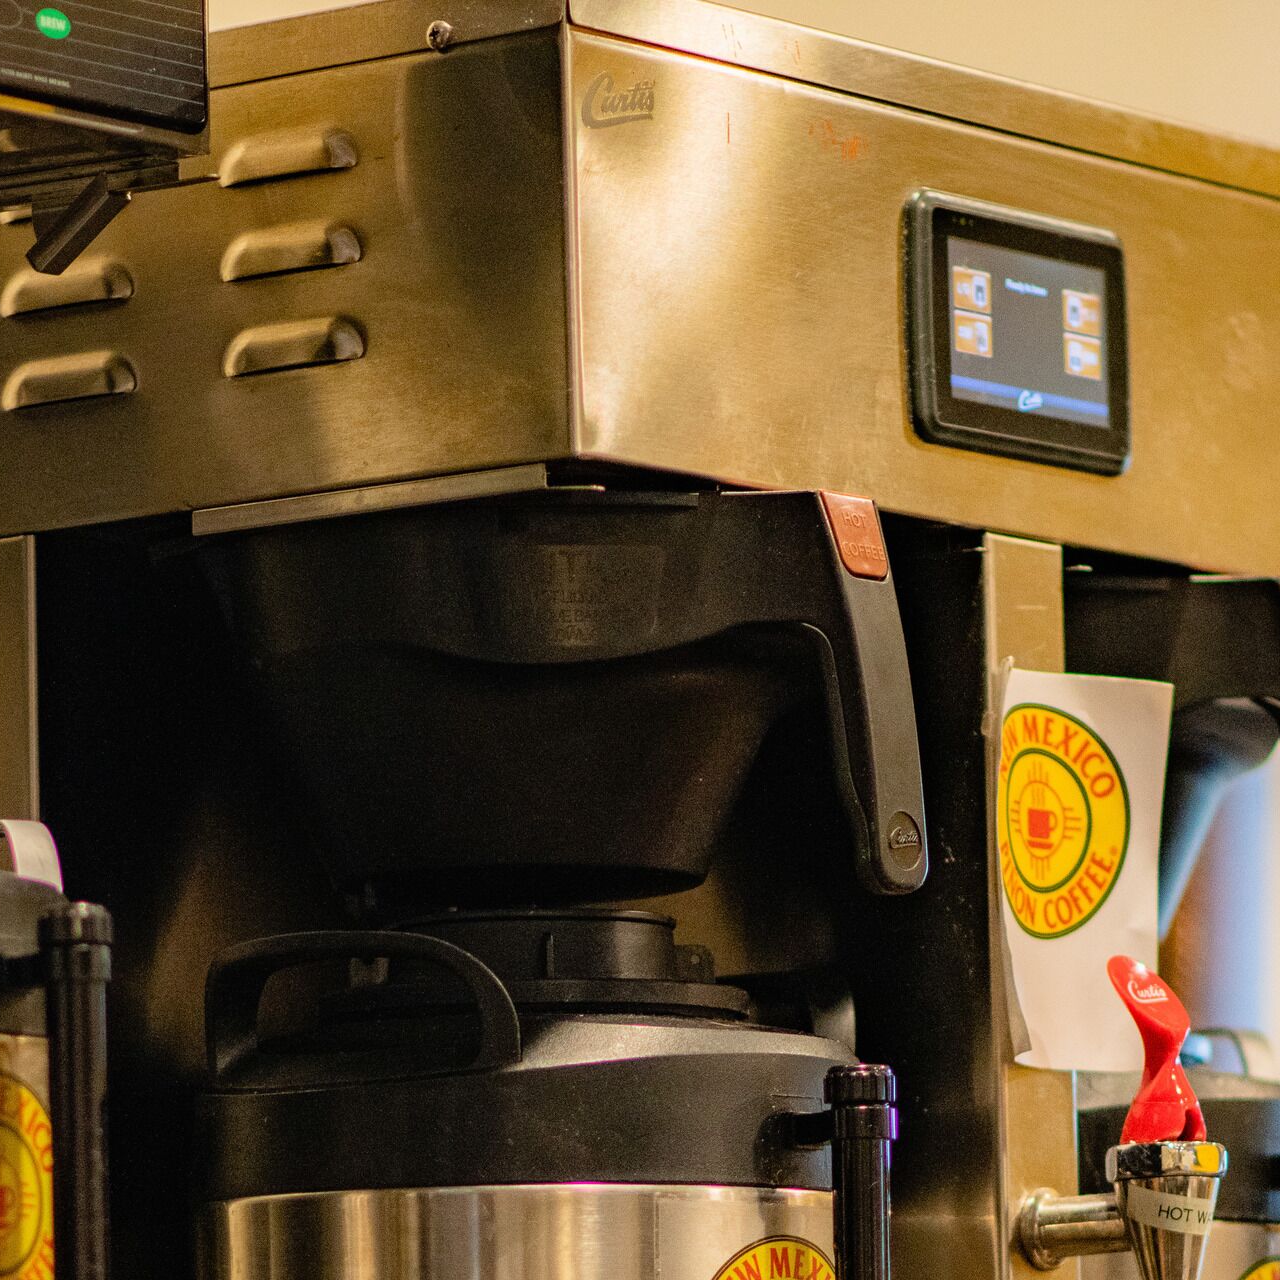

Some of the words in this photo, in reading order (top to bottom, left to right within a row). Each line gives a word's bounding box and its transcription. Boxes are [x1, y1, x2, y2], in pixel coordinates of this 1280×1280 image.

[581, 70, 656, 130] Curtis
[841, 511, 867, 529] HOT
[840, 541, 887, 561] COFFEE
[1022, 713, 1115, 798] MEXICO
[1127, 979, 1169, 1004] Curtis
[1158, 1204, 1194, 1223] HOT
